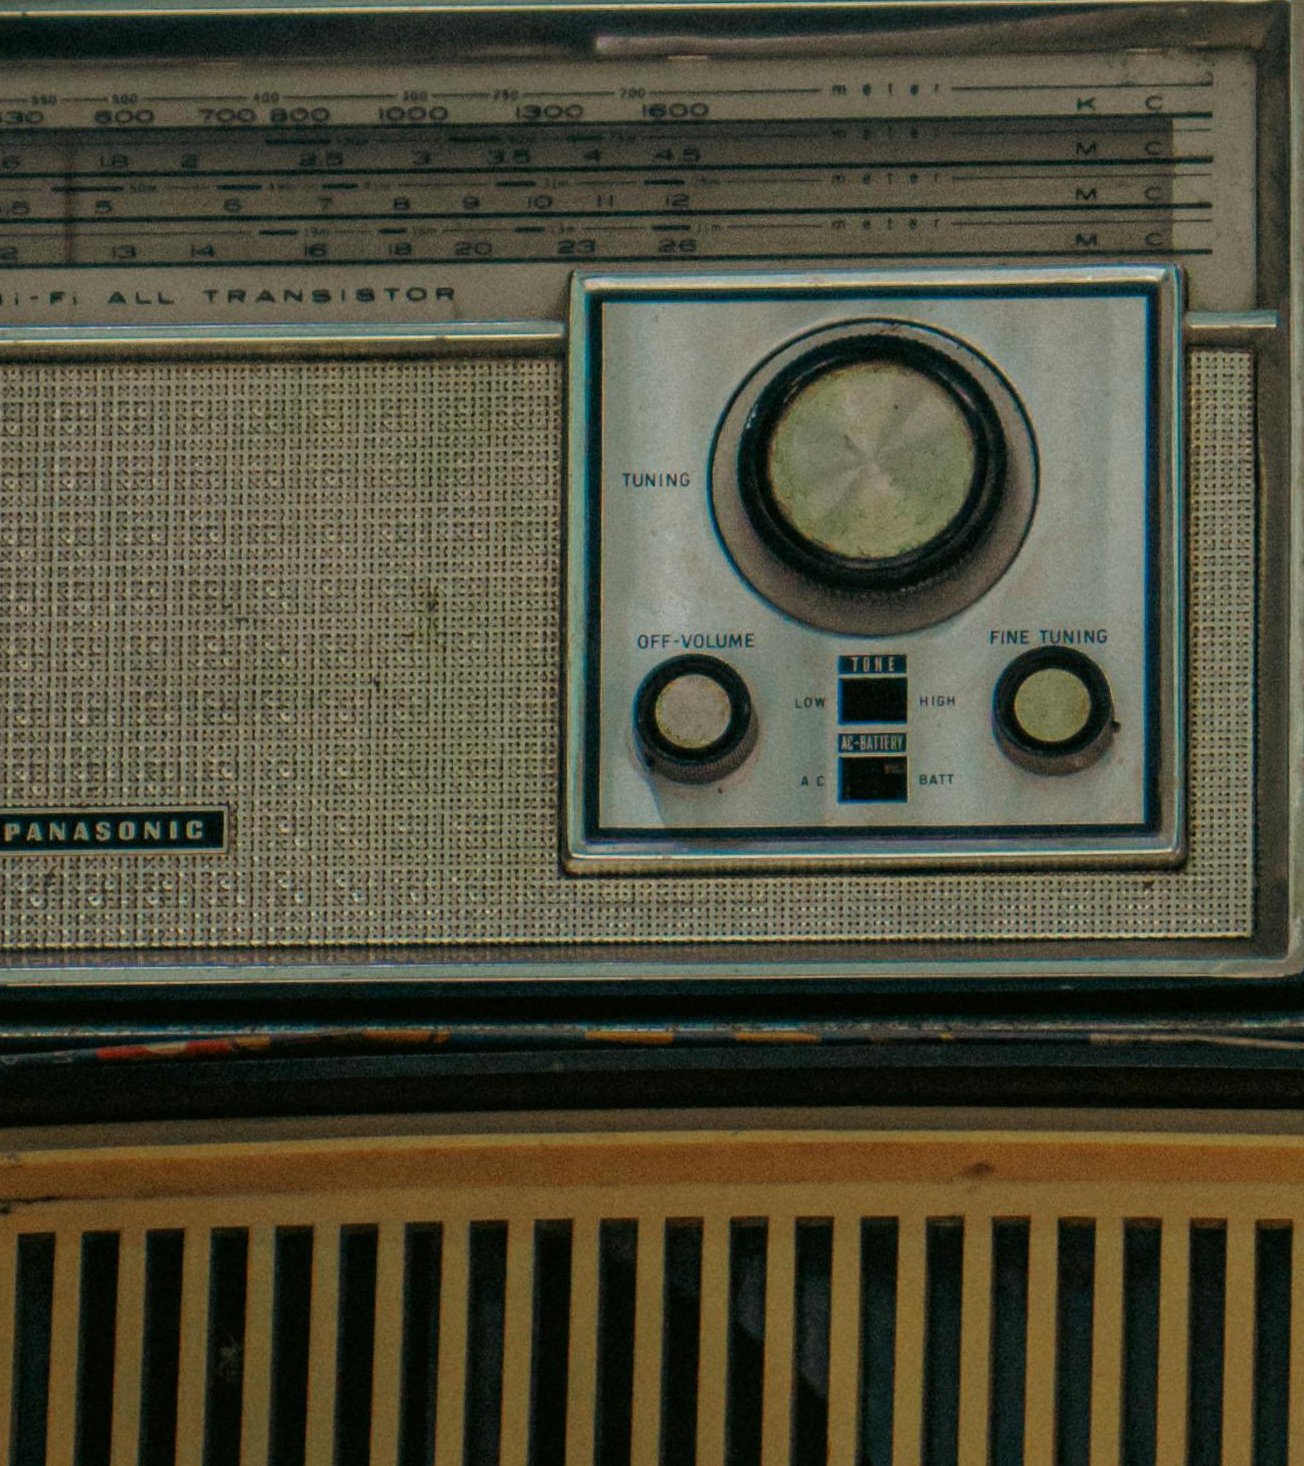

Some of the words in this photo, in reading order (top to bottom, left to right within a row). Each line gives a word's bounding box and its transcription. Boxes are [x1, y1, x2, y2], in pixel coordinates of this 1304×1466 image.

[95, 109, 155, 124] 600
[198, 108, 256, 124] 700
[269, 108, 331, 124] 800
[377, 105, 449, 122] 1000
[515, 103, 584, 120] 1300
[641, 102, 710, 119] 1600
[97, 199, 113, 214] 5
[223, 198, 241, 213] 6
[318, 197, 335, 213] 7
[393, 197, 410, 213] 8
[462, 196, 480, 212] 9
[528, 194, 554, 210] 10
[665, 193, 690, 209] 12
[112, 245, 138, 261] 13
[190, 244, 216, 260] 14
[387, 242, 413, 258] 18
[454, 242, 493, 258] 20
[557, 239, 596, 256] 23
[658, 239, 697, 255] 26
[108, 288, 175, 306] ALL
[203, 285, 457, 306] TRANSISTOR
[622, 472, 691, 488] TUNING
[637, 633, 756, 650] OFF-VOLUME
[989, 629, 1030, 646] FINE
[1039, 628, 1109, 645] TUNING
[850, 655, 897, 673] TONE
[795, 696, 826, 710] LOW
[919, 694, 956, 708] HIGH
[840, 734, 906, 752] AC-BATTERY
[918, 773, 955, 787] BATT
[2, 819, 206, 844] PANASONIC
